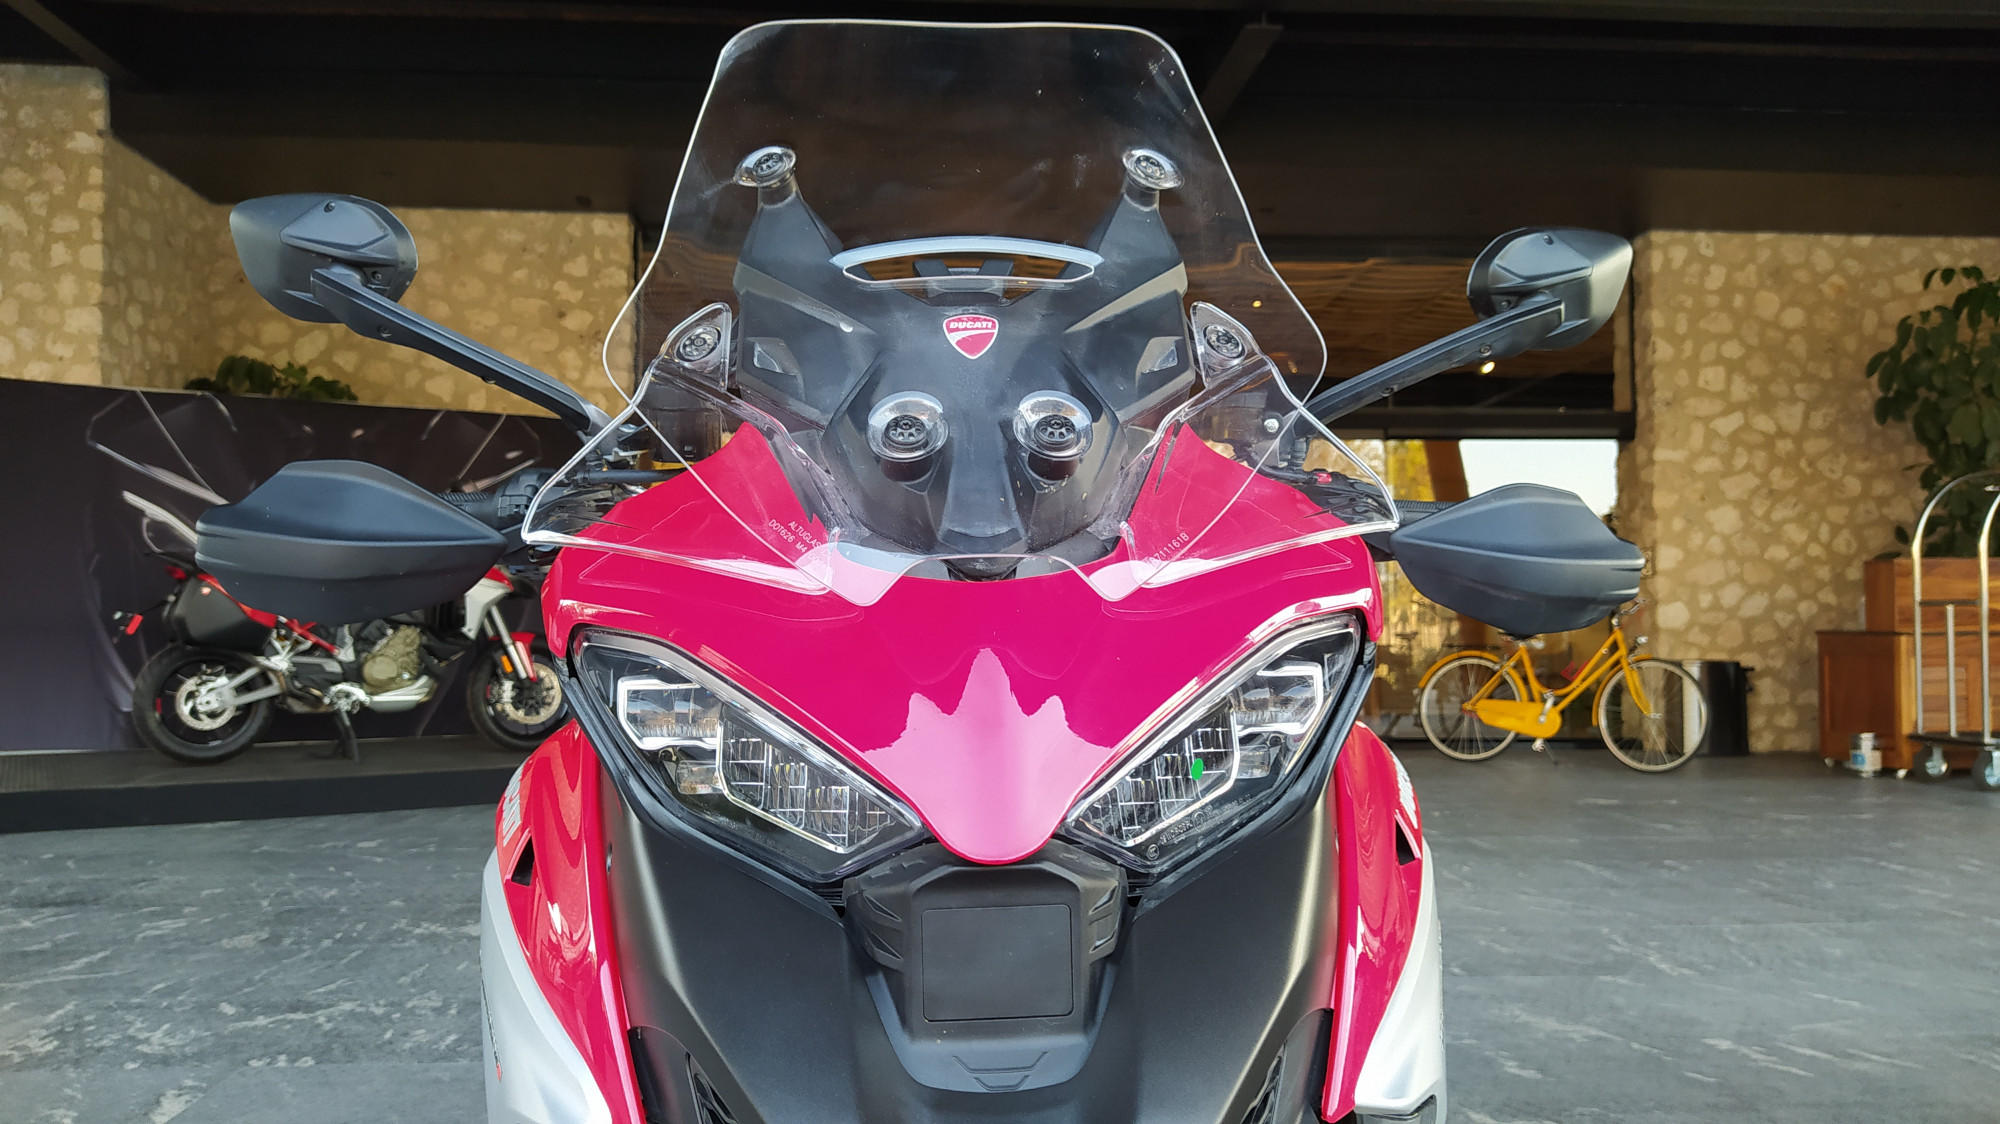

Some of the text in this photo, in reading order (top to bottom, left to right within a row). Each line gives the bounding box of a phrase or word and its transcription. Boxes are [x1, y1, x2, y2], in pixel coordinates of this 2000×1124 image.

[949, 321, 993, 329] DUCATI
[768, 519, 807, 553] DOT626 M4
[788, 521, 822, 549] ALTUGLAS
